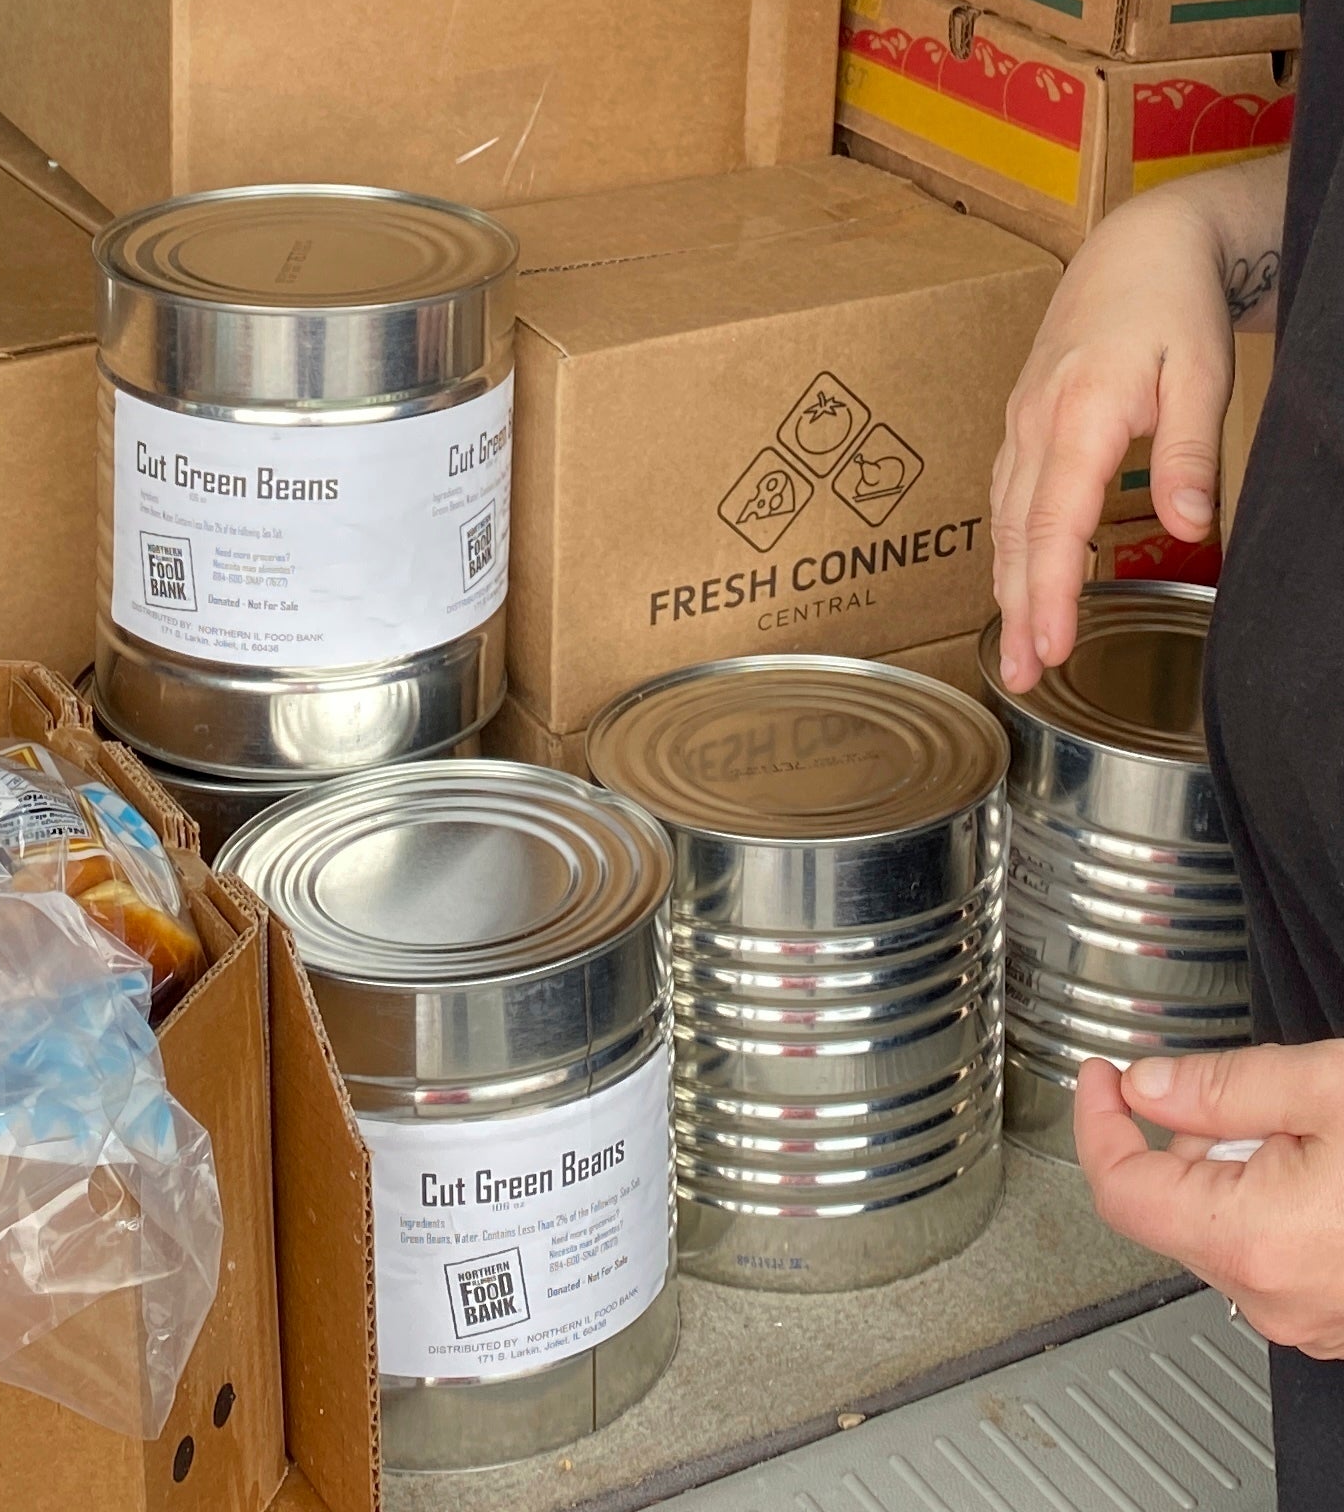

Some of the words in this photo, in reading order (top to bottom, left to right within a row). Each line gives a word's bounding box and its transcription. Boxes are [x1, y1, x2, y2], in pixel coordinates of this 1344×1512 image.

[136, 440, 167, 483] Cut
[174, 454, 247, 498] Green
[257, 467, 339, 501] Beans
[449, 443, 475, 477] Cut
[649, 564, 778, 626] FRESH
[791, 516, 983, 592] CONNECT
[150, 577, 187, 601] BANK
[207, 593, 240, 608] Donated
[247, 599, 262, 610] Not
[263, 600, 278, 611] For
[279, 601, 299, 611] Sale
[757, 588, 877, 632] CENTRAL
[198, 624, 251, 641] NORTHERN
[264, 633, 294, 642] FOOD
[295, 633, 325, 642] BANK
[421, 1172, 466, 1207] Cut
[475, 1169, 553, 1204] Green
[561, 1139, 626, 1188] Beans
[517, 1224, 536, 1235] Less
[537, 1219, 555, 1232] Than
[551, 1231, 569, 1246] Need
[457, 1261, 510, 1283] NORTHERN
[547, 1277, 581, 1299] Donated
[587, 1271, 600, 1285] Not
[601, 1265, 613, 1277] For
[614, 1255, 629, 1271] Sale
[427, 1341, 502, 1355] DISTRIBUTED
[526, 1319, 584, 1344] NORTHERN
[584, 1314, 593, 1325] IL
[594, 1302, 619, 1321] FOOD
[619, 1286, 640, 1307] BANK
[463, 1295, 518, 1327] BANK
[477, 1355, 494, 1365] 171
[572, 1331, 581, 1341] IL
